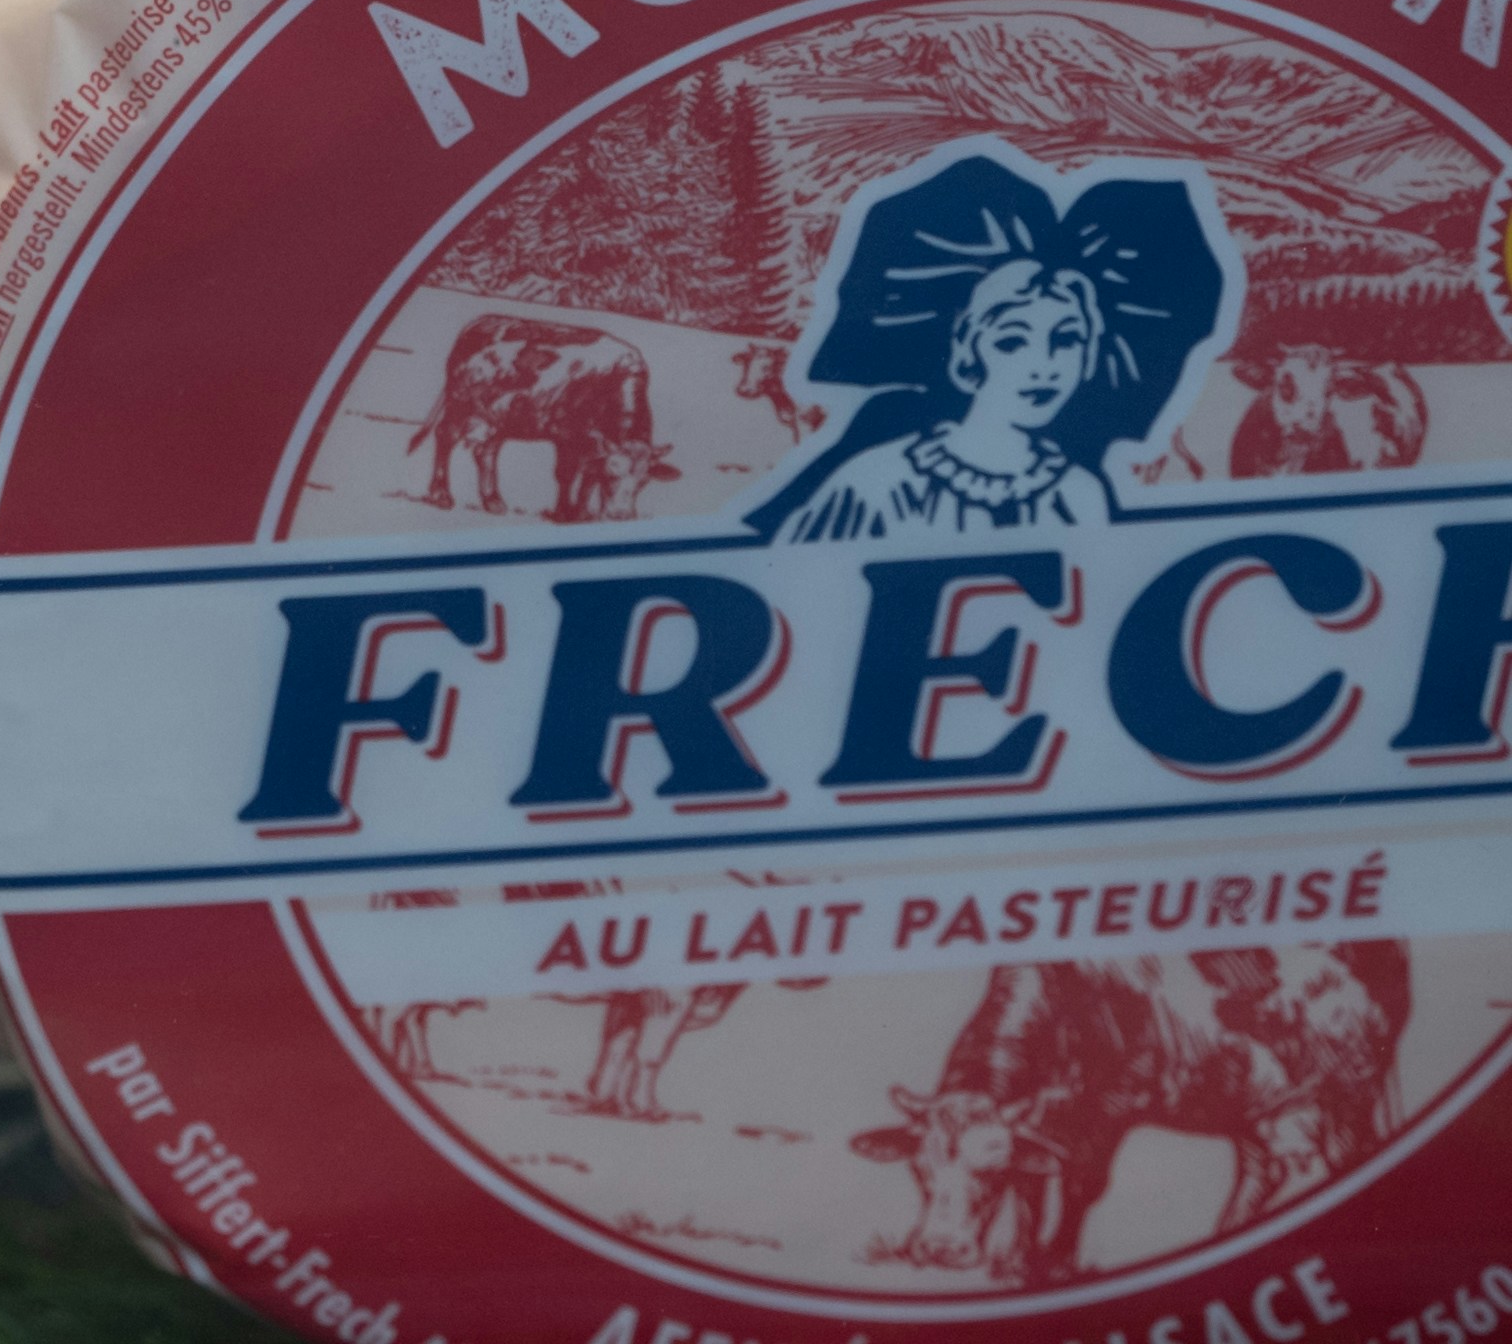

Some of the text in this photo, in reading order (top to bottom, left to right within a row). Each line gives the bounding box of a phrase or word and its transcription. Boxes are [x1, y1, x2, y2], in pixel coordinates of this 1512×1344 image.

[38, 98, 86, 153] Lait
[71, 46, 184, 173] Mindestens
[536, 849, 1390, 973] AU LAIT PASTEURISÉ
[86, 1042, 175, 1123] par
